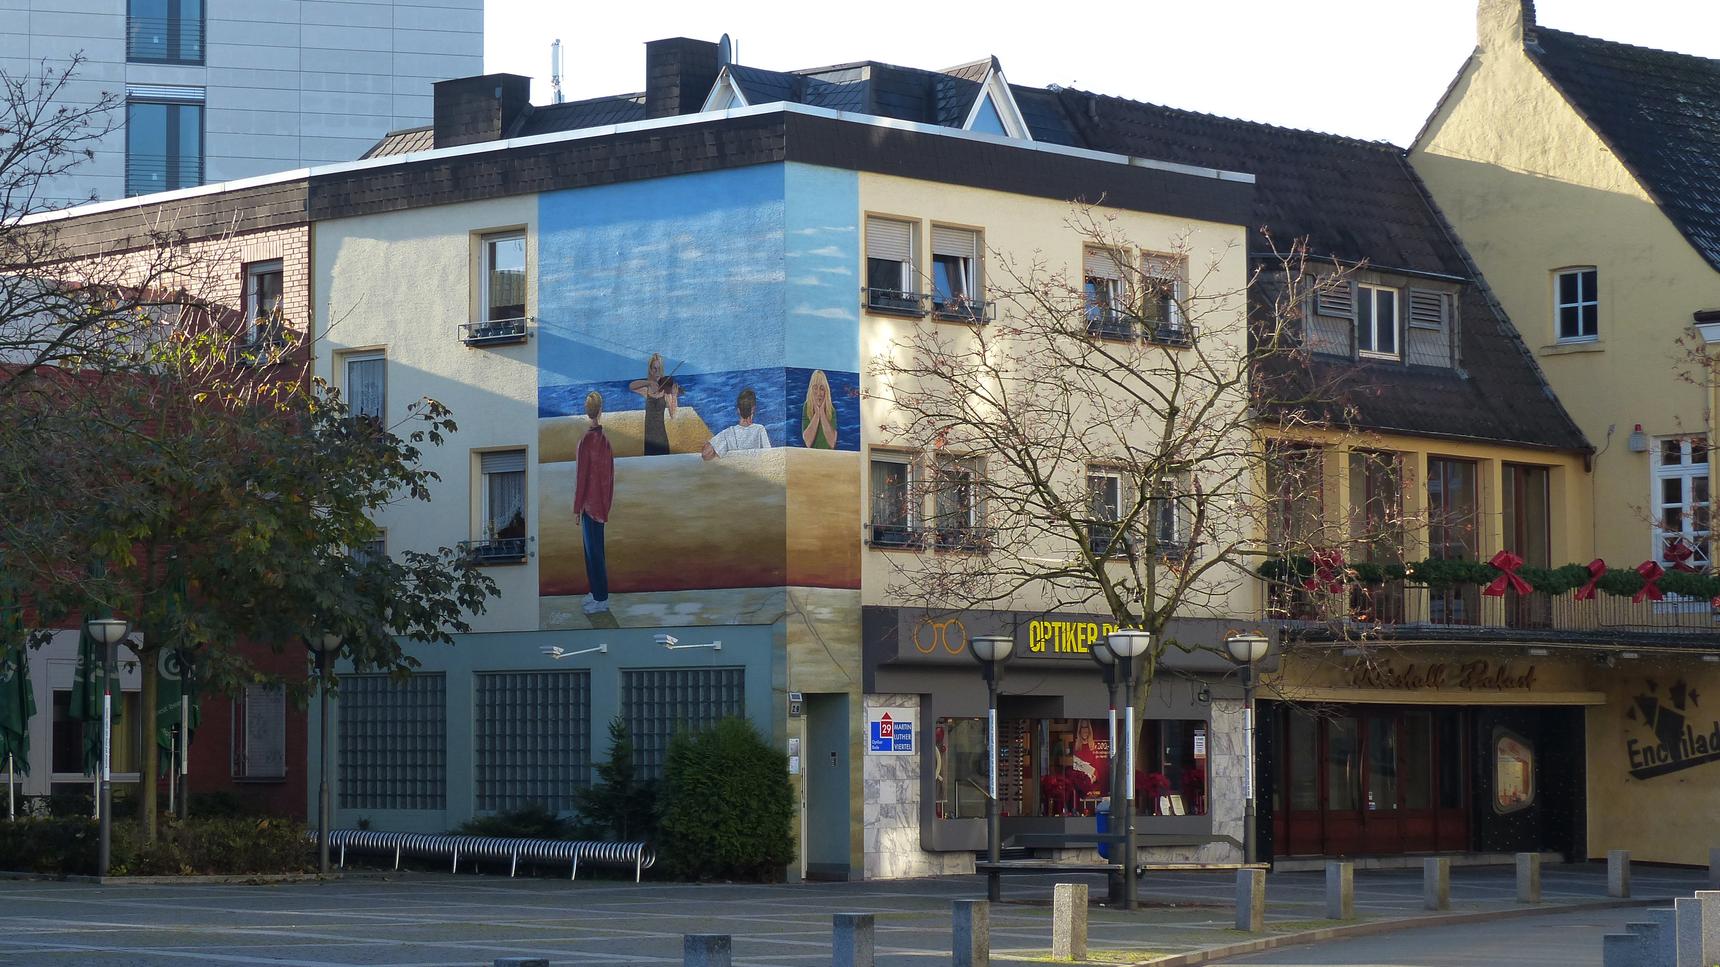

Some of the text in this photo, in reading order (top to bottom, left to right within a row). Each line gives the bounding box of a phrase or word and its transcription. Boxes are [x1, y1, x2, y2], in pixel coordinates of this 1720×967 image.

[1029, 620, 1098, 653] OPTIKER
[882, 724, 891, 734] 29
[894, 733, 911, 741] LUTHER
